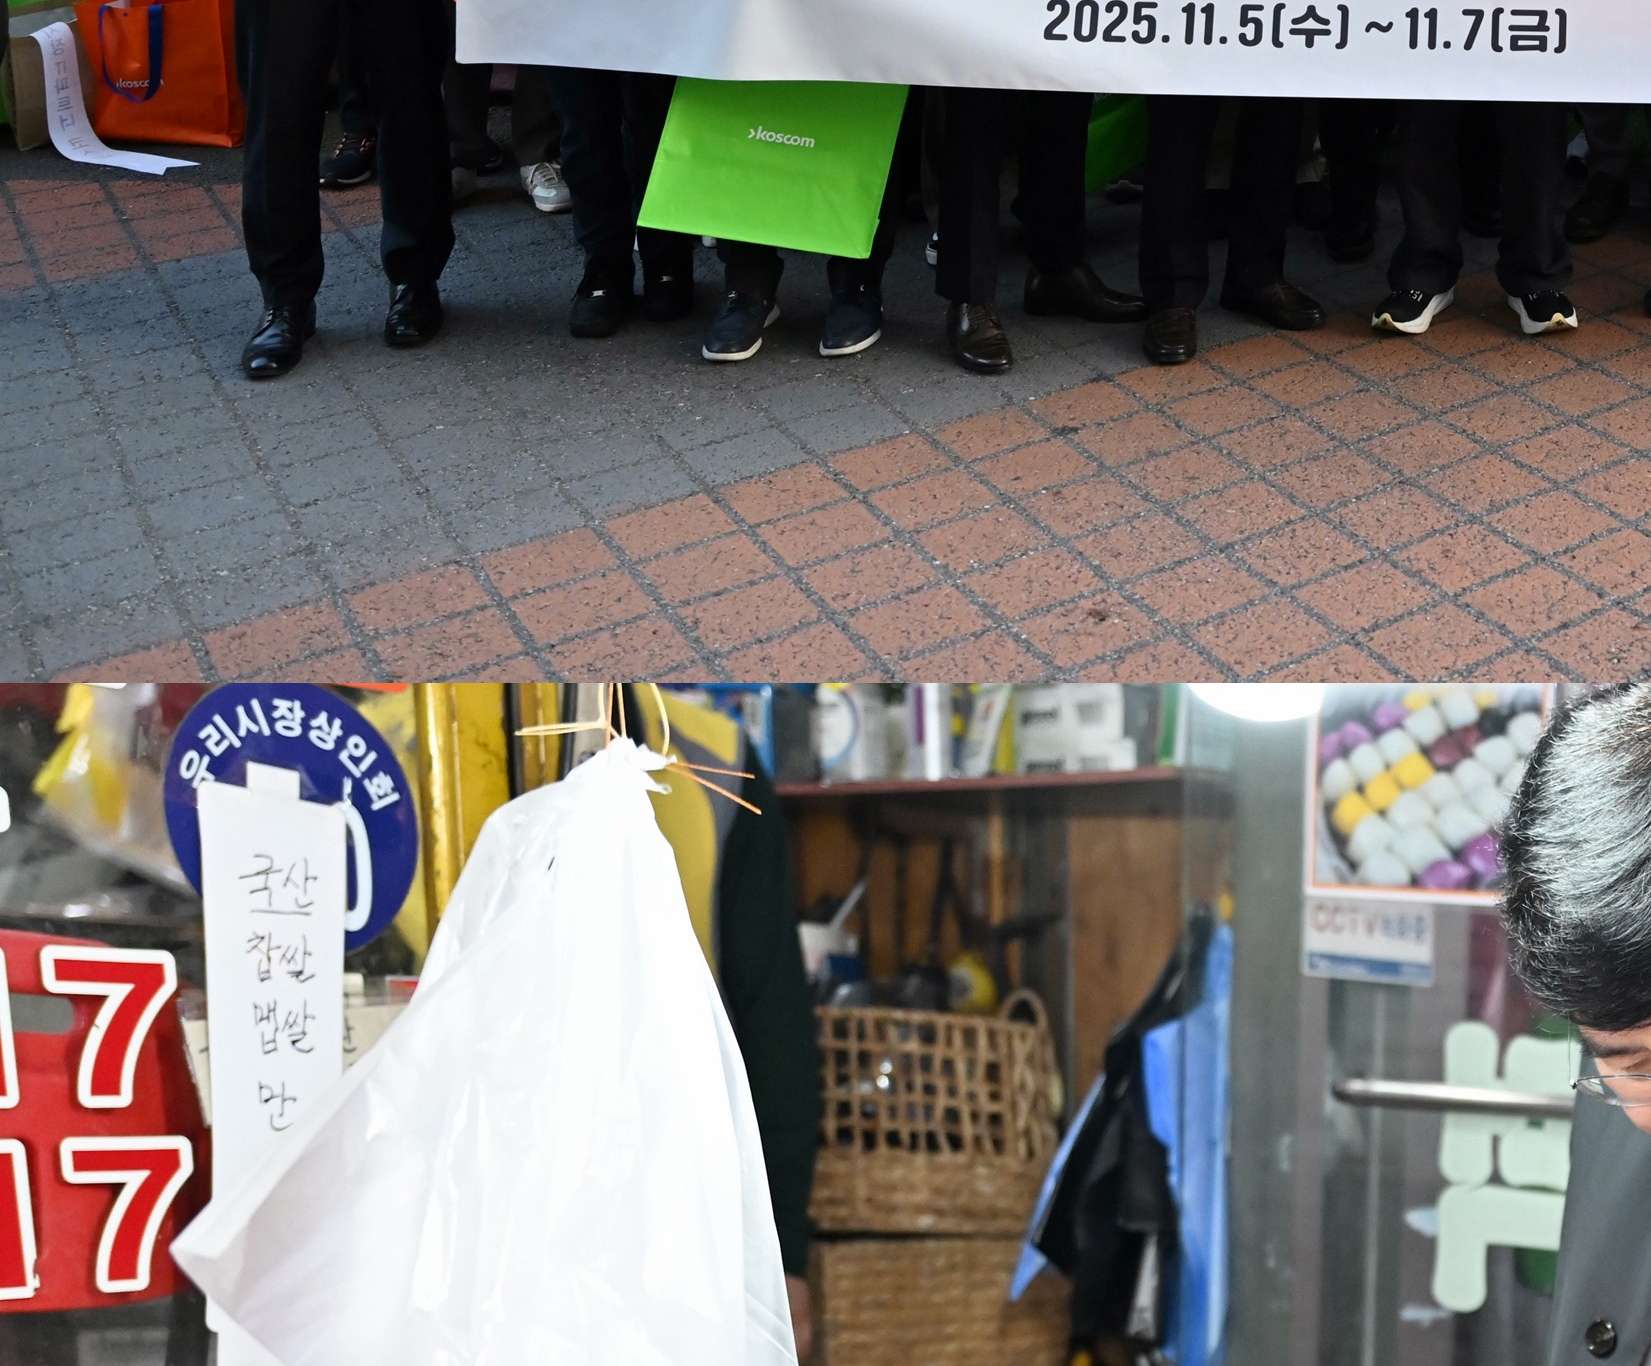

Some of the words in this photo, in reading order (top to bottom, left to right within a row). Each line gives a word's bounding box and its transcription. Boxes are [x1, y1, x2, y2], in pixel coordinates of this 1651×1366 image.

[756, 126, 815, 148] koscom
[238, 853, 318, 909] 국산
[246, 931, 316, 984] 찹쌀
